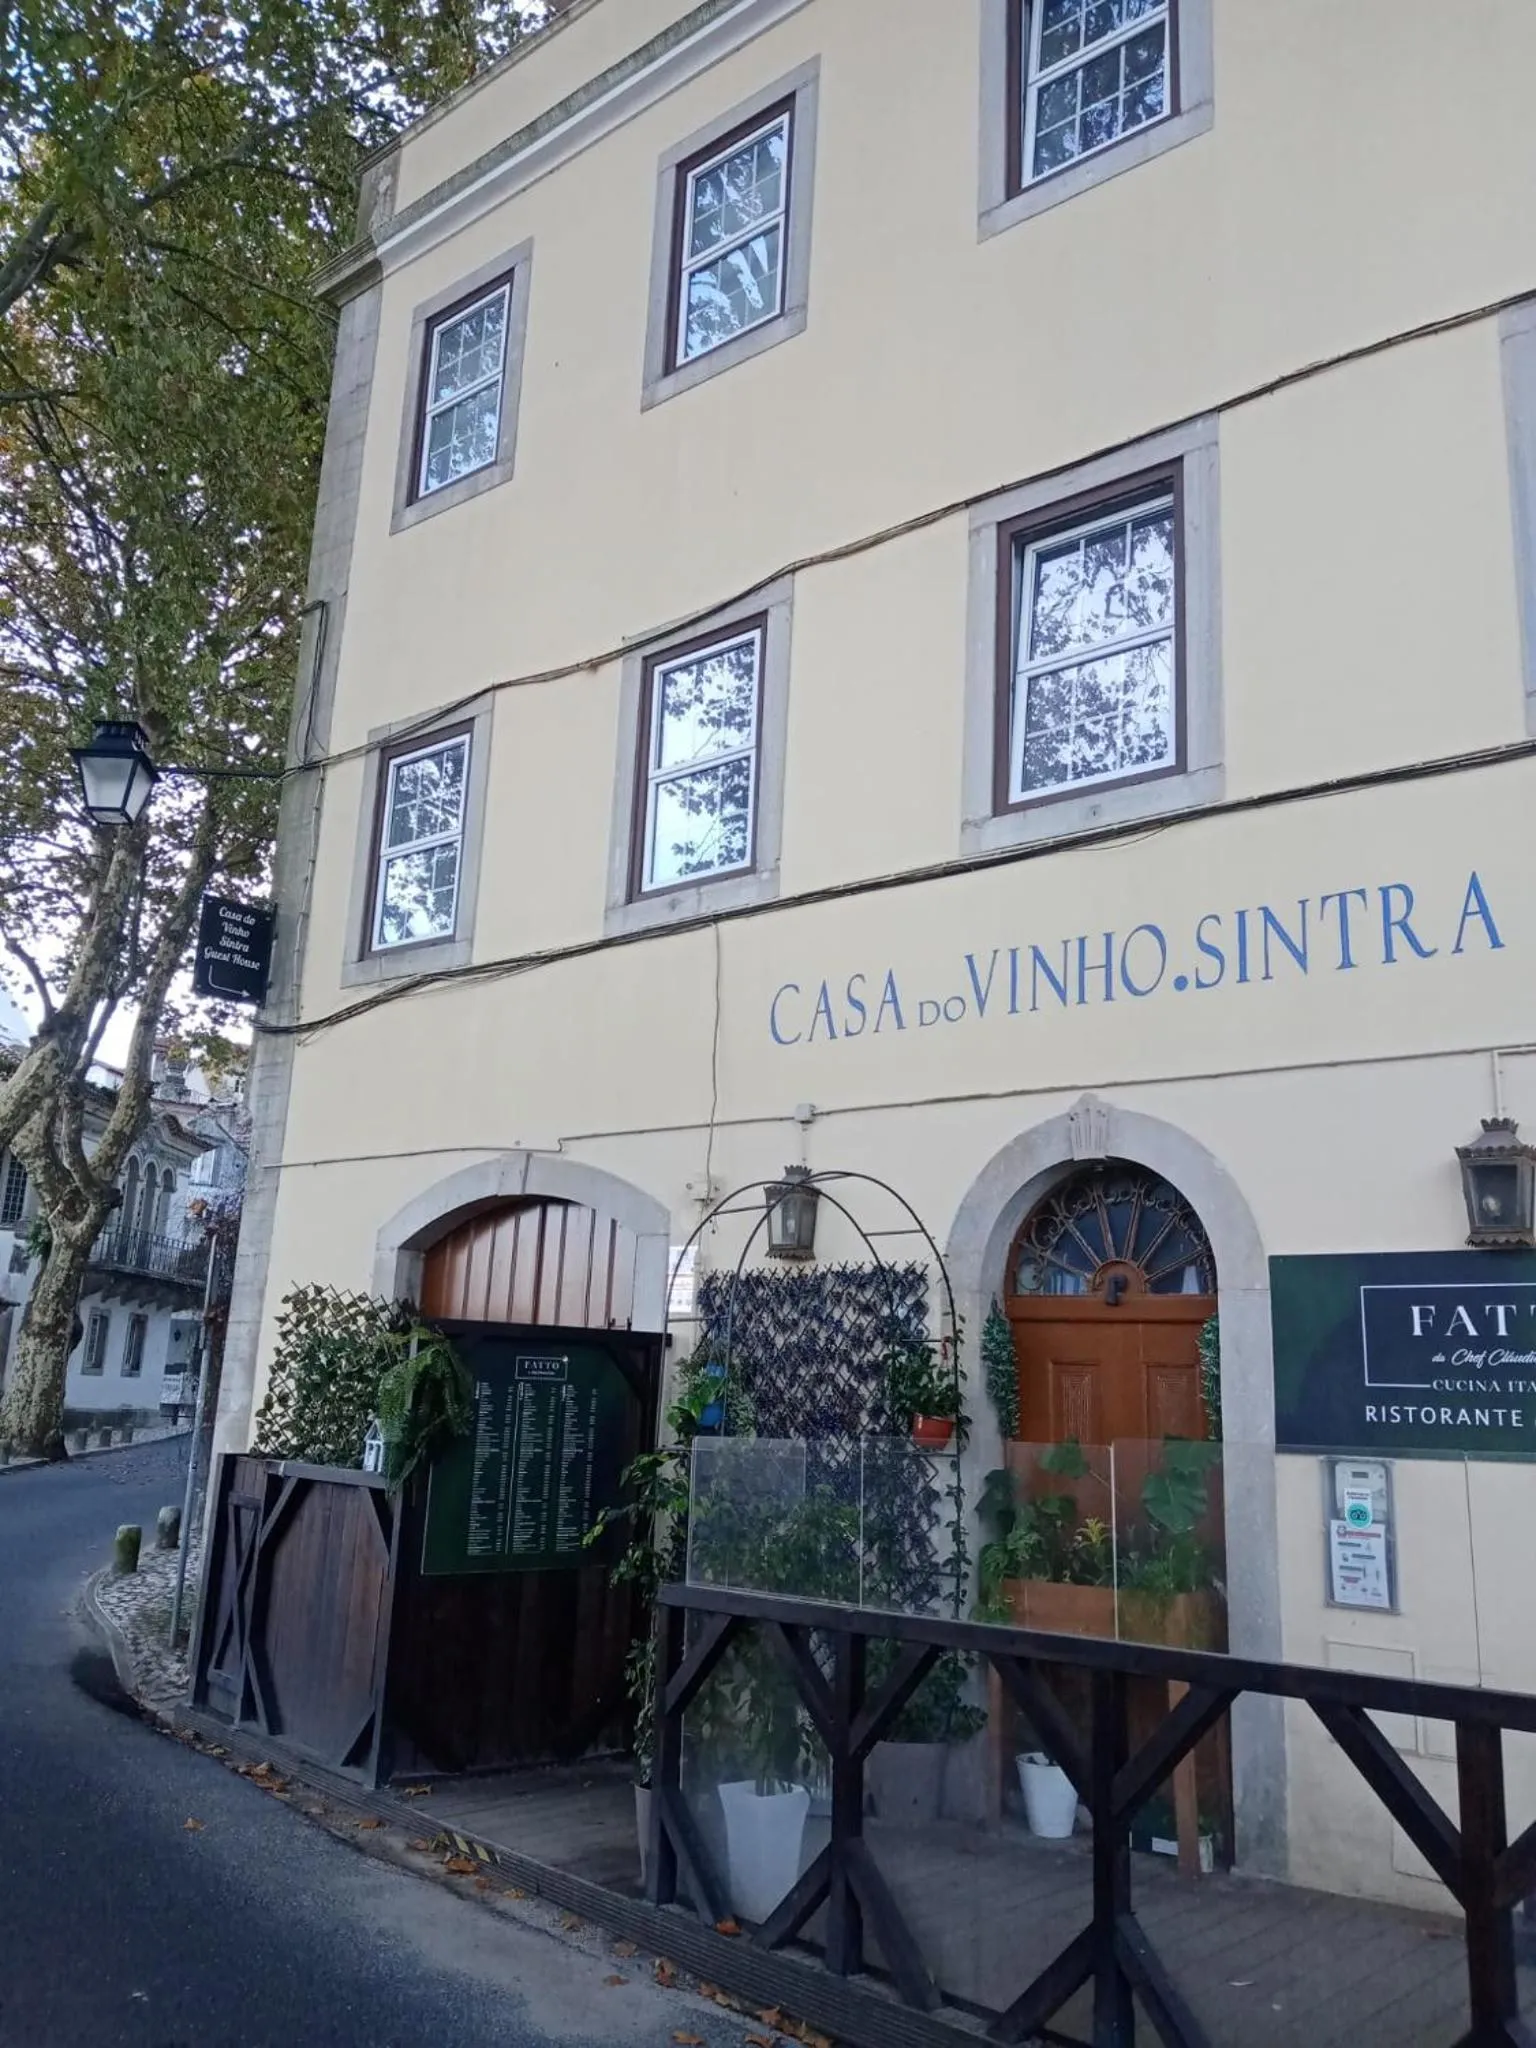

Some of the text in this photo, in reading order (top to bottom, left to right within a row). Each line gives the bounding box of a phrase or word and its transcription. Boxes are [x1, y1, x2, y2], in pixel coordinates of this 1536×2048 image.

[219, 906, 242, 921] Casa
[222, 922, 250, 937] Vinho
[219, 936, 250, 952] Sintra
[204, 946, 261, 971] Guest House
[769, 968, 907, 1046] CASA
[1451, 1348, 1488, 1369] Chef
[1432, 1379, 1501, 1393] CUCINA
[1365, 1404, 1524, 1427] RISTORANTE
